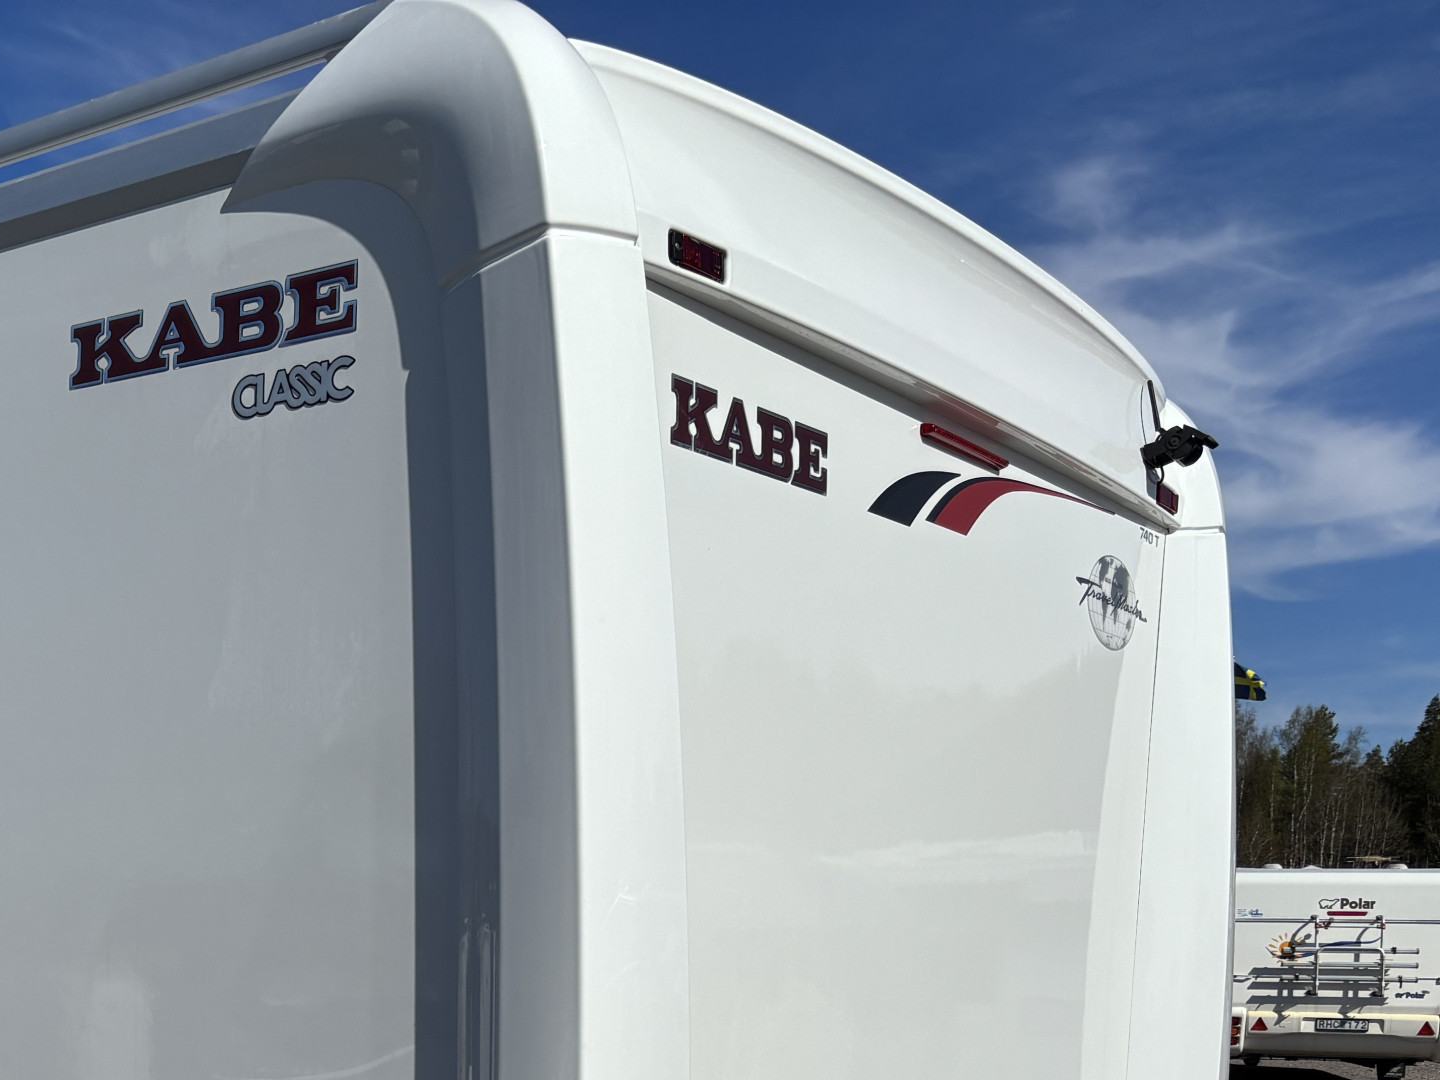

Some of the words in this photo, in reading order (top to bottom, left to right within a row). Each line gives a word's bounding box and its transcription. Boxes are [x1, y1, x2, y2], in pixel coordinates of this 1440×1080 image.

[69, 259, 359, 391] KABE
[231, 355, 356, 421] CLASSIC
[670, 373, 829, 497] KABE
[1139, 526, 1154, 545] 740
[1154, 534, 1160, 548] T
[1340, 897, 1376, 910] Polar
[1348, 1021, 1368, 1030] 172
